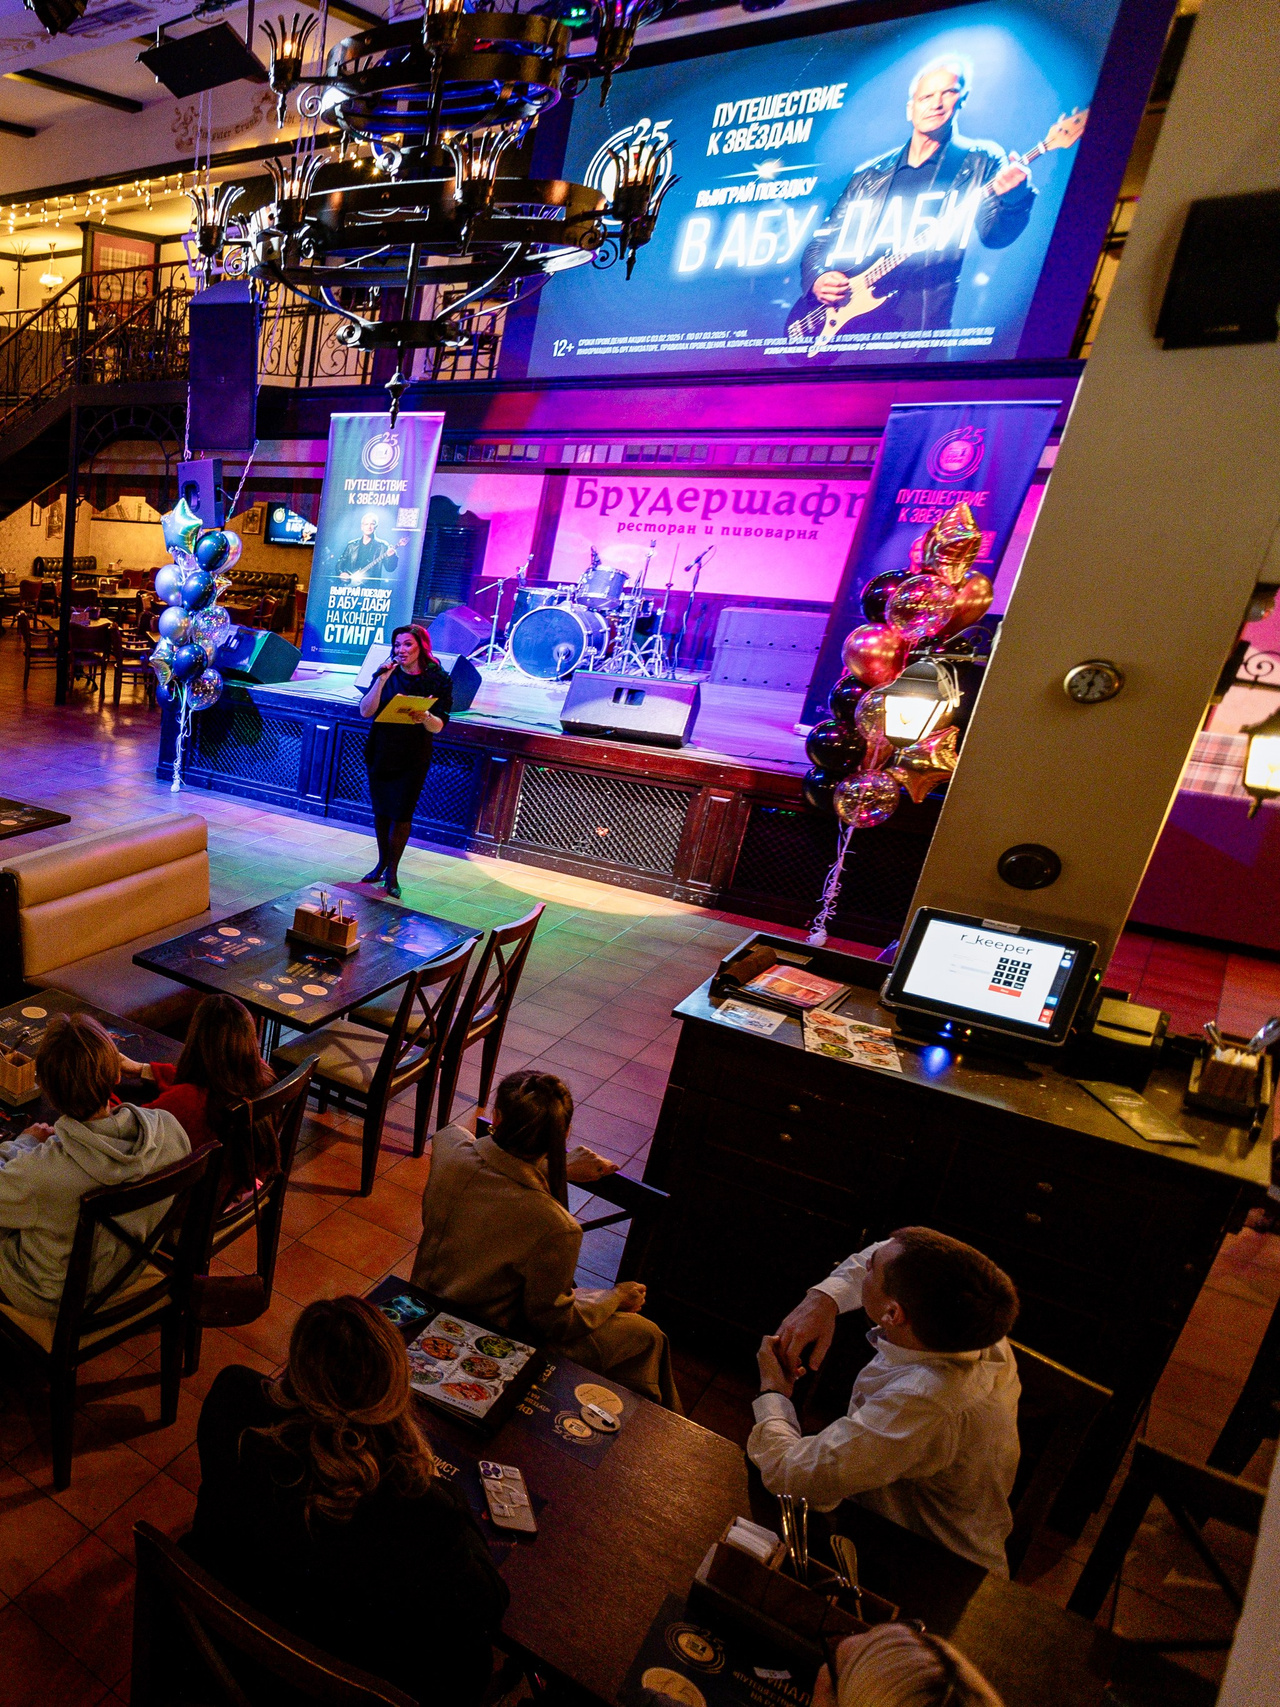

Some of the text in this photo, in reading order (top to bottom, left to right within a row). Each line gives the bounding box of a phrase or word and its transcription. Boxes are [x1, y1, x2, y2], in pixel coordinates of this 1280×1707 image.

[712, 82, 848, 128] ПУТЕШЕСТВИЕ
[631, 117, 673, 151] 25
[706, 118, 814, 157] К ЗВЁЗДАМ
[695, 176, 818, 208] ВЫИГРАЙ ПОЕЗДКУ
[678, 187, 983, 273] В АБУ-ДАБИ
[552, 339, 574, 358] 12+
[382, 431, 399, 447] 25
[962, 425, 987, 445] 25
[344, 478, 408, 491] ПУТЕШЕСТВИЕ
[348, 491, 401, 506] К ЗВЁЗДАМ
[897, 505, 950, 524] К ЗВЁЗ
[617, 521, 819, 541] ресторан и пивоварня
[329, 586, 392, 599] ВЫИГРАЙ ПОЕЗДКУ
[328, 595, 391, 612] В АБУ-ДАБИ
[326, 609, 388, 627] НА КОНЦЕРТ
[324, 623, 384, 646] СТИНГА
[960, 933, 1034, 955] r_keeper
